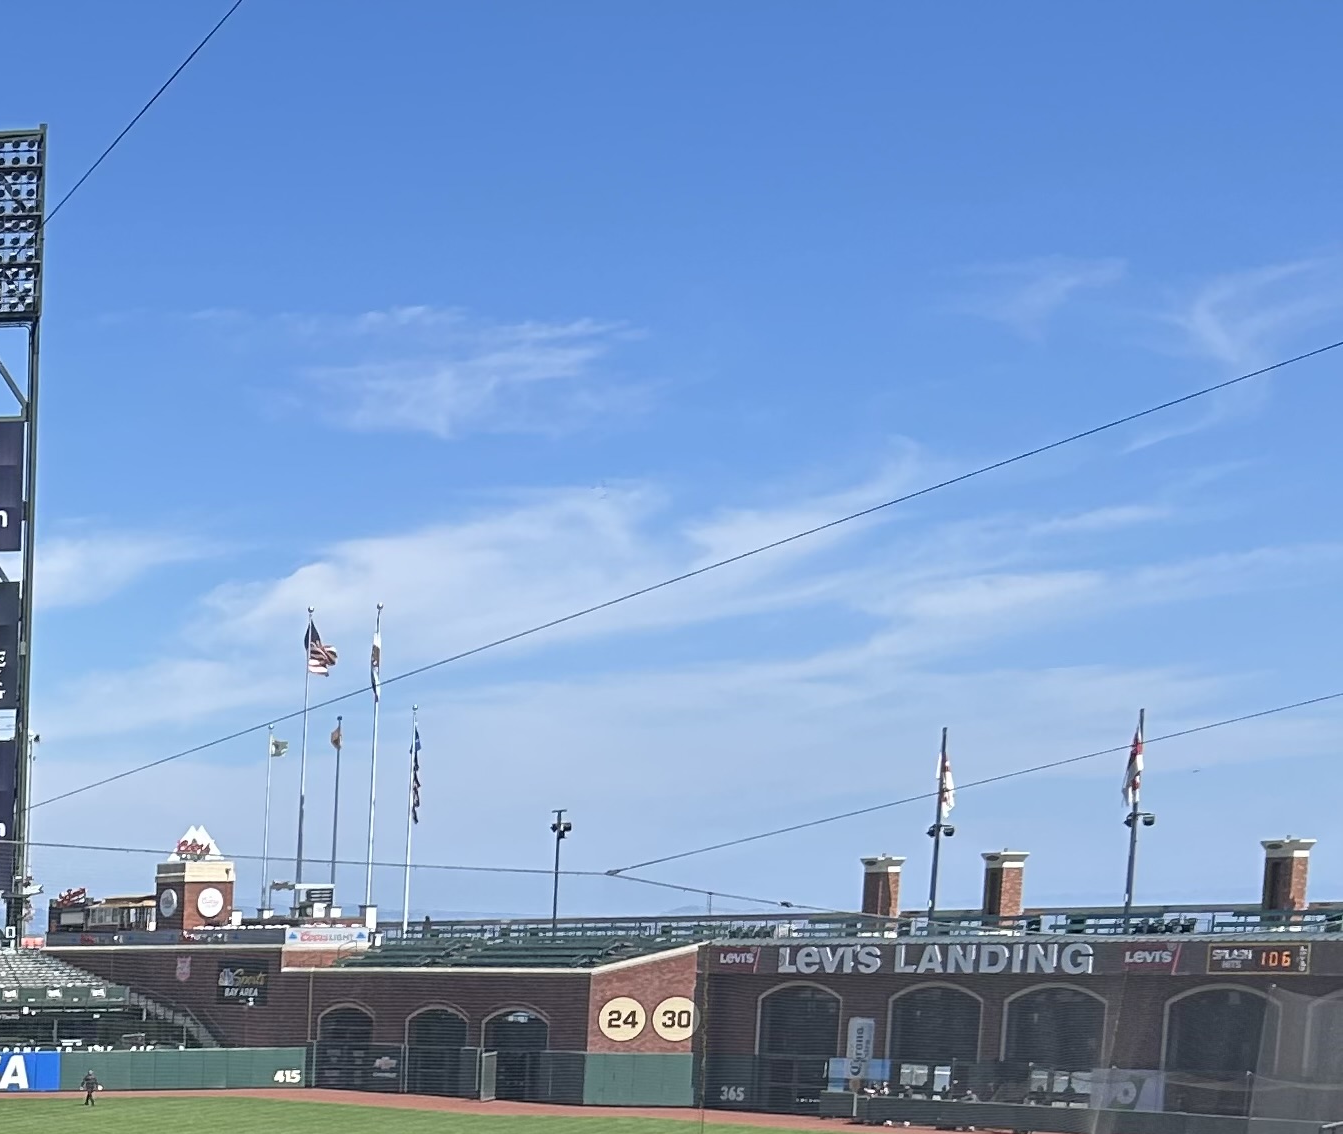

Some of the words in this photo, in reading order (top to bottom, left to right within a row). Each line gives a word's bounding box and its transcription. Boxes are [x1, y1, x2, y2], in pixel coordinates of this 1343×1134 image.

[327, 933, 354, 942] LIGHT
[894, 942, 1094, 975] LANDING
[1212, 949, 1253, 960] SPLASH
[1261, 951, 1292, 967] 106
[1221, 960, 1242, 969] HITS
[224, 987, 240, 997] BAY
[240, 987, 259, 997] AREA
[607, 1010, 638, 1028] 24
[662, 1009, 691, 1029] 30
[850, 1027, 865, 1077] Corona
[273, 1068, 301, 1083] 415
[720, 1085, 745, 1101] 365
